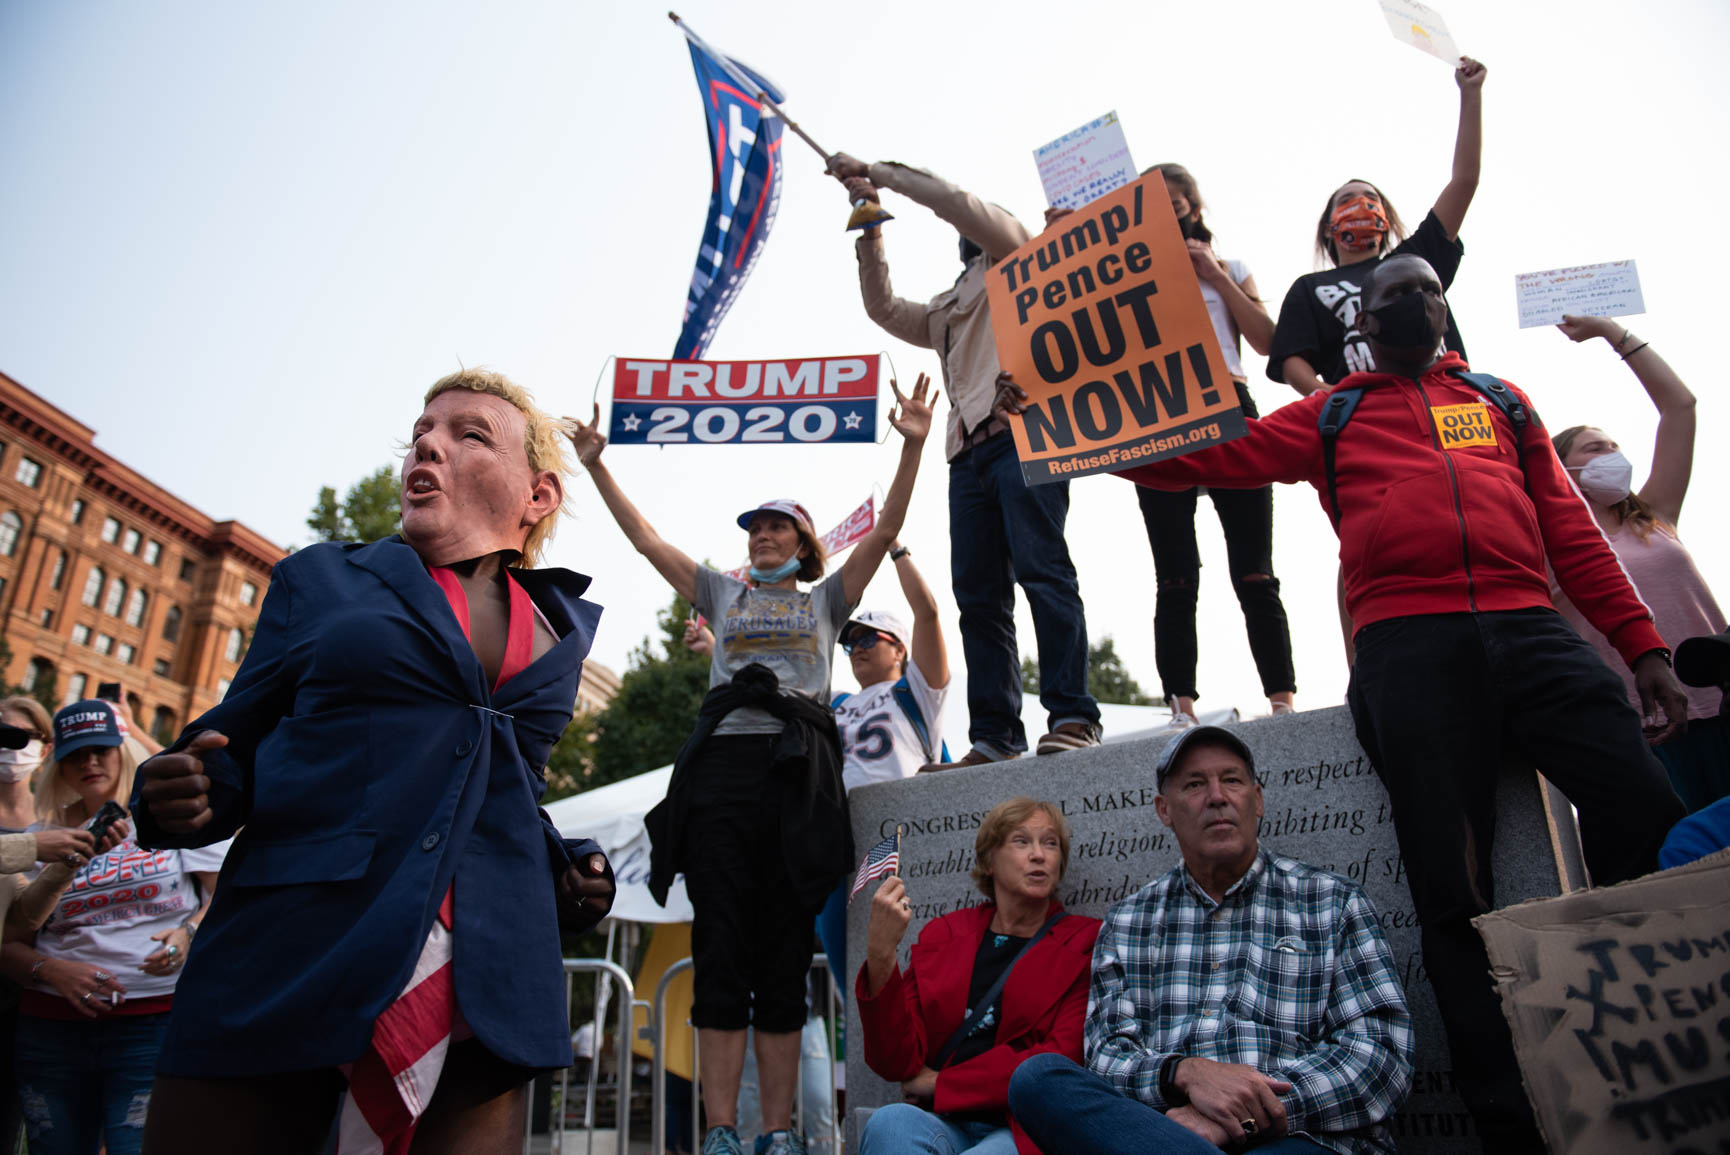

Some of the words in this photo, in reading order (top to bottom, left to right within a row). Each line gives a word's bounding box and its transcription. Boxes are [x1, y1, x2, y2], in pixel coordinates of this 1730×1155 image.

[1000, 184, 1144, 293] Trump/
[1015, 241, 1152, 325] Pence
[1030, 280, 1162, 384] OUT
[625, 359, 868, 398] TRUMP
[1021, 343, 1221, 453] NOW!
[647, 405, 837, 443] 2020
[1442, 426, 1492, 444] NOW
[1443, 412, 1483, 428] OUT
[1048, 421, 1222, 475] RefuseFascism.org
[725, 615, 817, 633] JERUSALEM
[60, 712, 107, 728] TRUMP
[1082, 788, 1154, 814] MAKE
[1256, 804, 1366, 839] hibiting
[909, 849, 975, 876] establi
[1078, 829, 1172, 862] religion,
[1347, 848, 1376, 886] of
[63, 850, 171, 895] RUMP
[61, 882, 162, 919] 2020
[1633, 971, 1730, 1021] PEN
